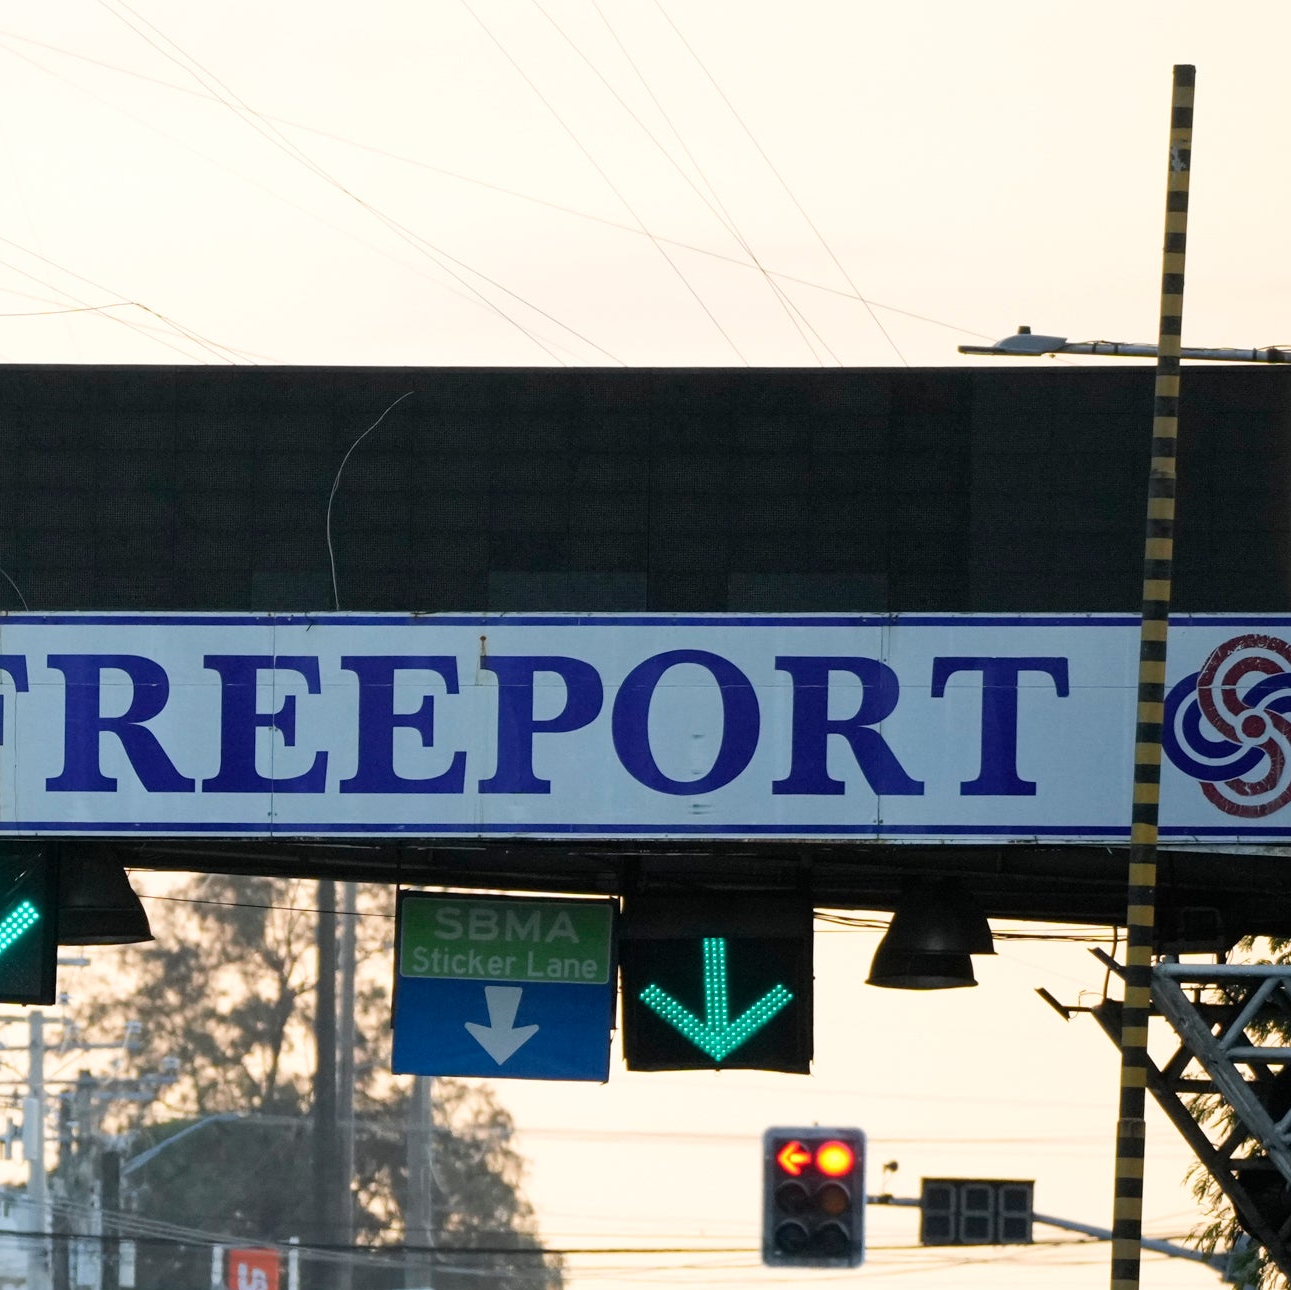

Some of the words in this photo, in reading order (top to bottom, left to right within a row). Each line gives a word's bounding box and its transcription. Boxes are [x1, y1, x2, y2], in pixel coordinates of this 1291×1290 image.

[434, 907, 580, 943] SBMA
[412, 946, 517, 977] Sticker
[527, 952, 598, 980] Lane
